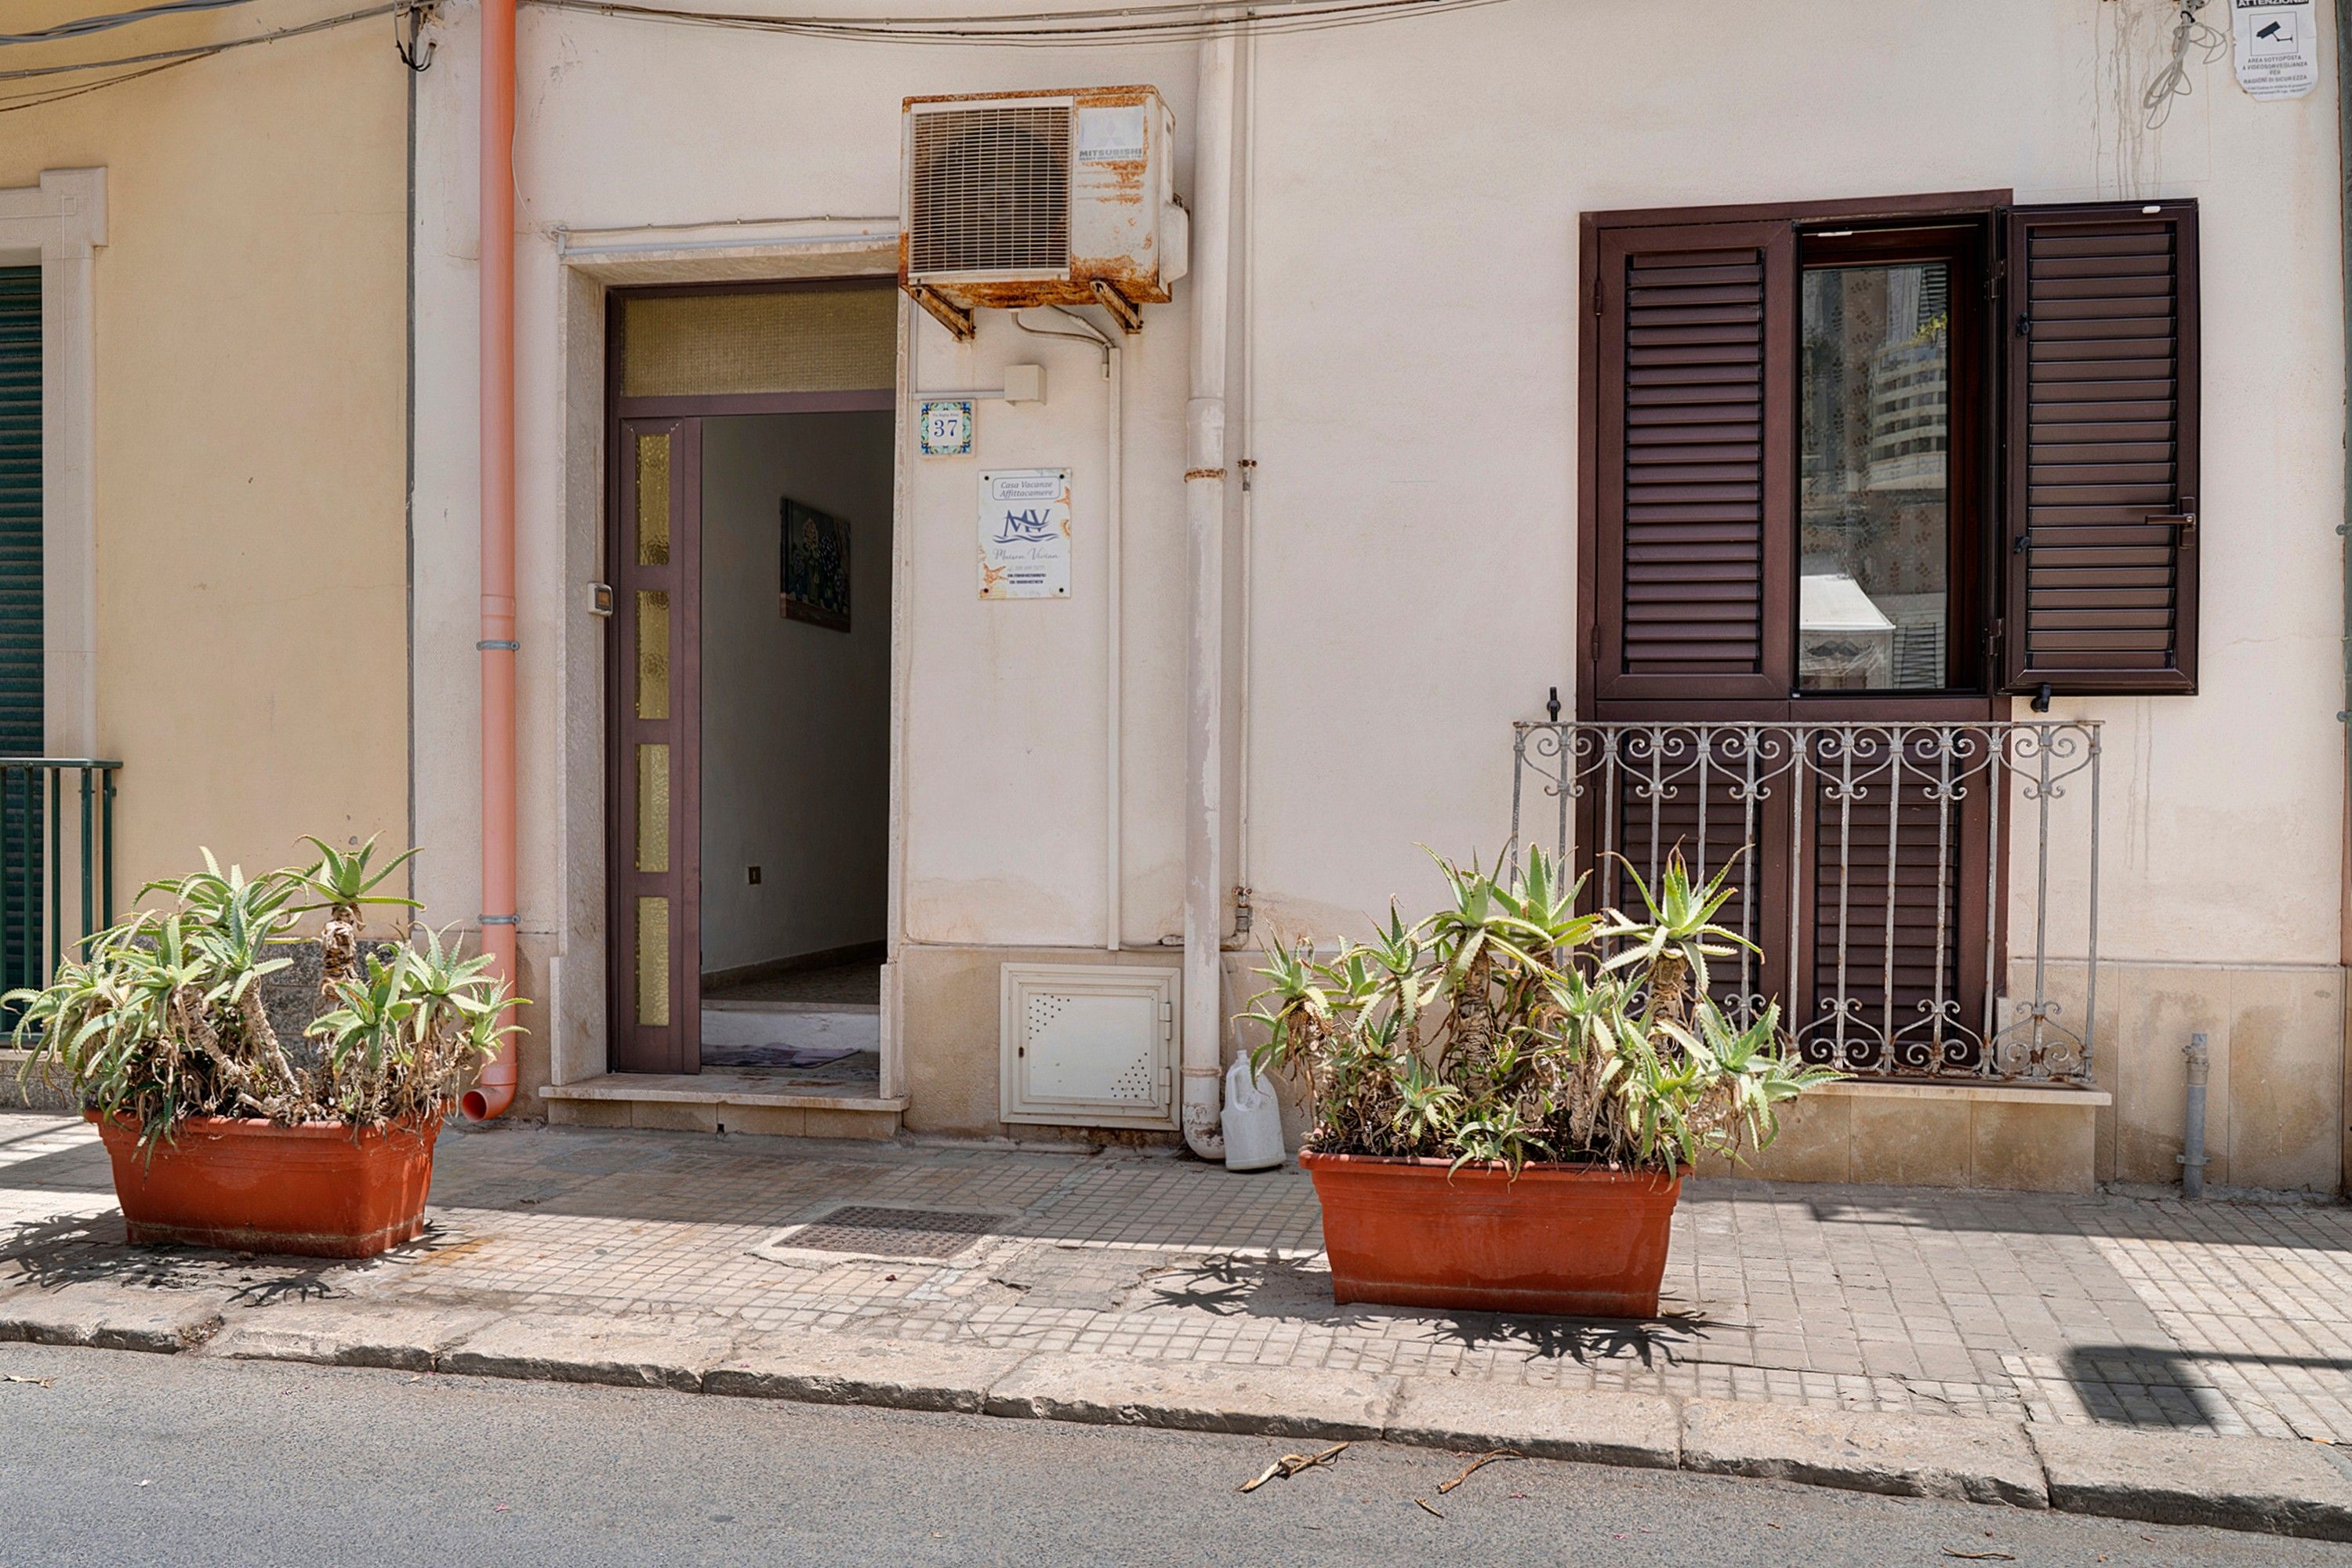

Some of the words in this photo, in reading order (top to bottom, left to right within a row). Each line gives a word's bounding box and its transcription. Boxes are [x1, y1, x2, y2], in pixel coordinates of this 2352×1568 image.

[1080, 148, 1142, 158] MITSUBISHI
[934, 419, 957, 437] 37
[1000, 489, 1053, 499] Affittacamere
[993, 547, 1025, 561] Maison
[1027, 546, 1059, 561] Vivian
